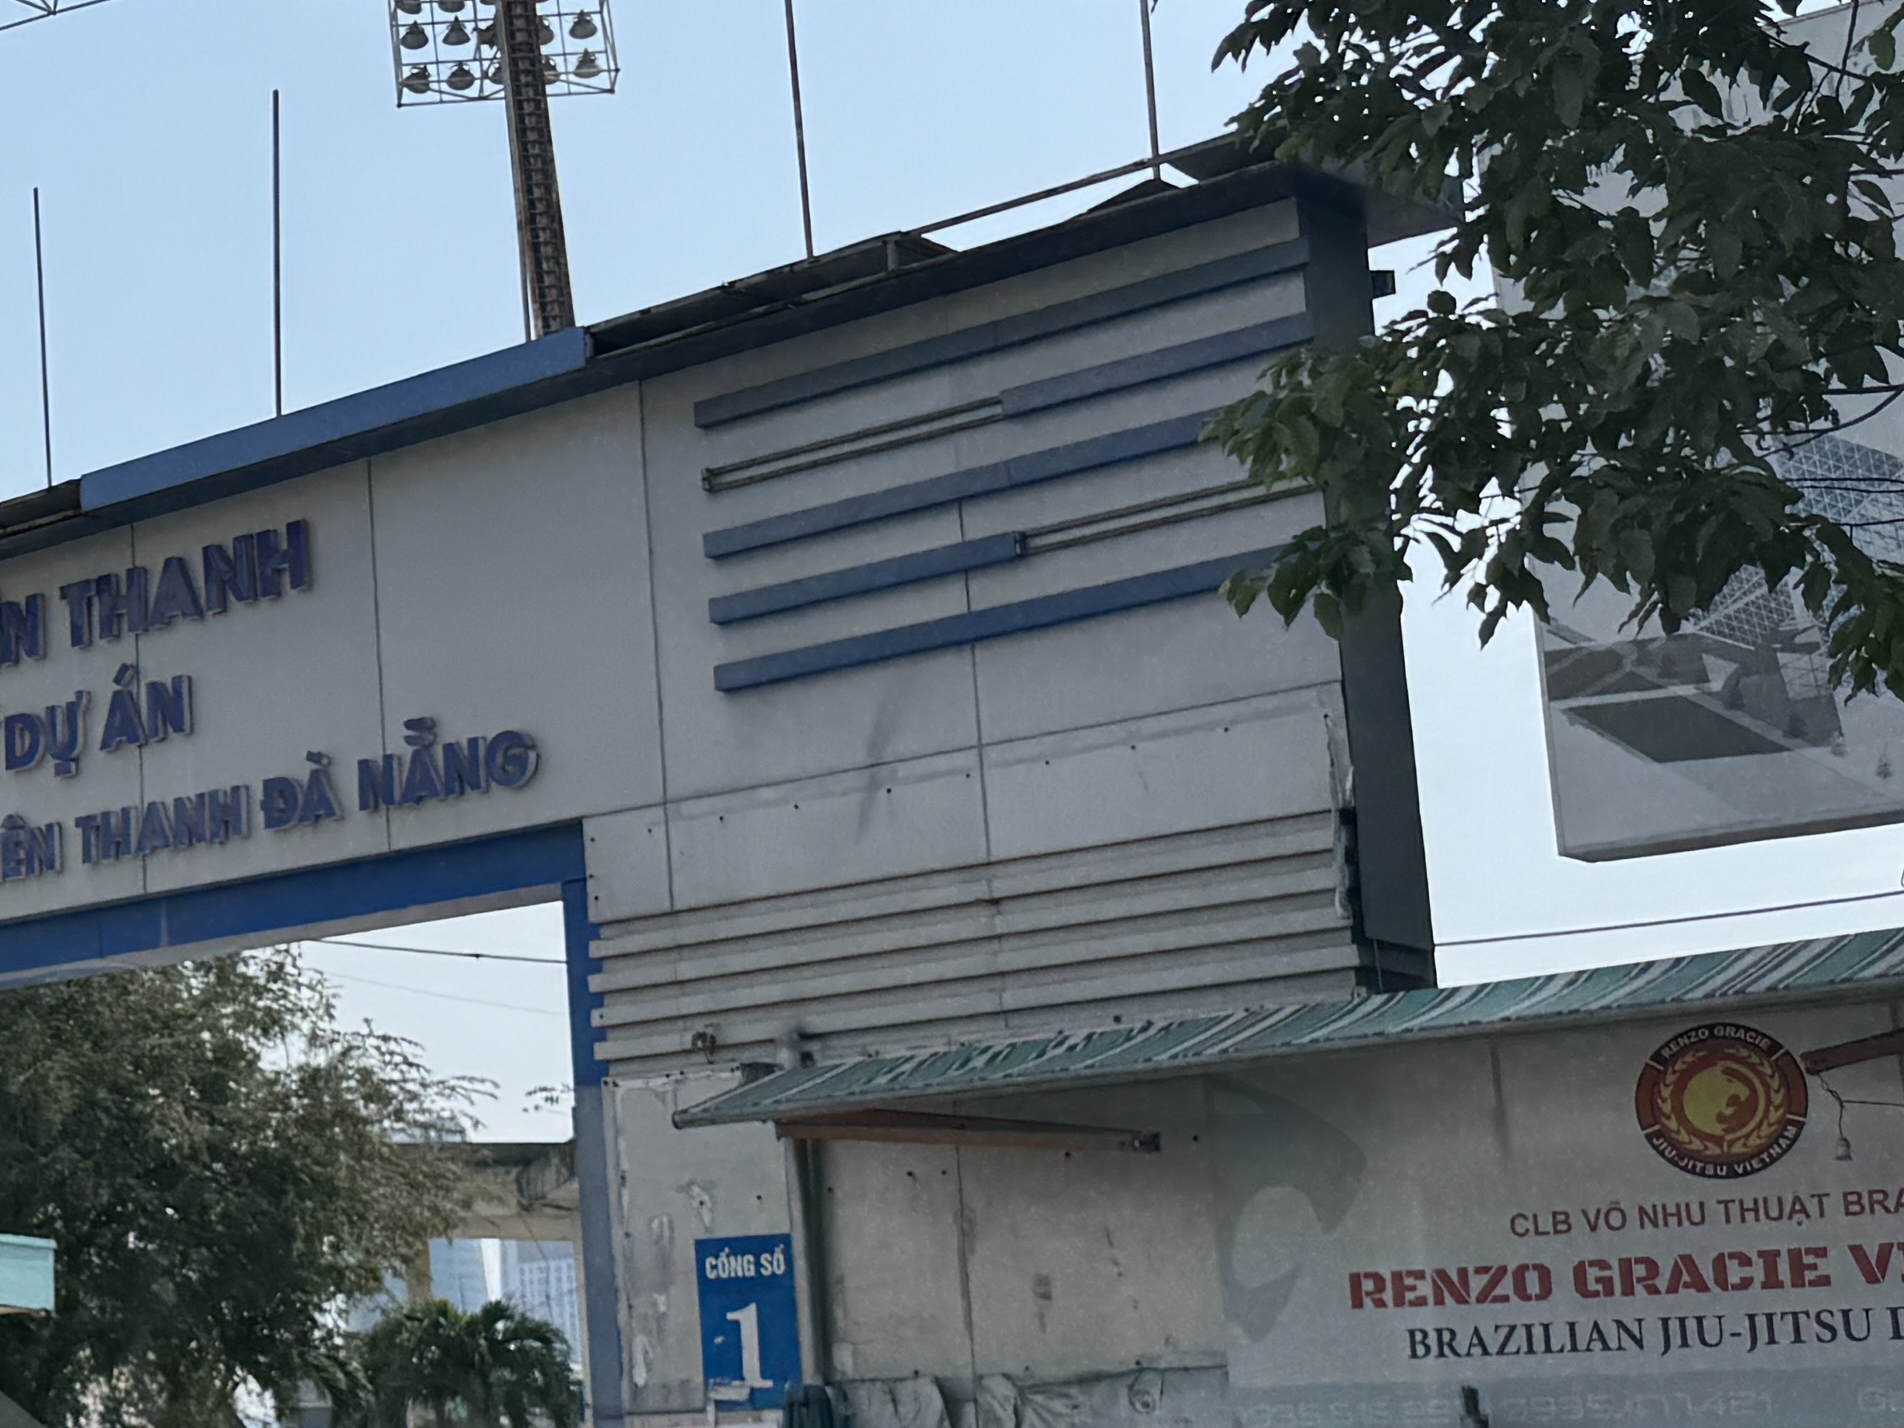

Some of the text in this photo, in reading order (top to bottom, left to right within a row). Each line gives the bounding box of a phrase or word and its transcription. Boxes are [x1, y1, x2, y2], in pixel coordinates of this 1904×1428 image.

[59, 518, 314, 650] THANH
[4, 689, 91, 779] DỰ
[99, 662, 193, 753] ÁN
[75, 784, 250, 866] THANH
[260, 750, 345, 832] ĐÀ
[357, 716, 542, 812] NẴNG
[1660, 1025, 1771, 1059] RENZO GRACIE
[1733, 1124, 1799, 1175] VIETNAM
[1510, 1210, 1572, 1238] CLB
[1638, 1200, 1707, 1231] NHU
[760, 1243, 786, 1276] SỐ
[1348, 1262, 1553, 1310] RENZO
[1572, 1246, 1832, 1299] GRACIE
[725, 1302, 774, 1389] 1
[1406, 1317, 1645, 1360] BRAZILIAN
[1657, 1307, 1874, 1357] JIU-JITSU
